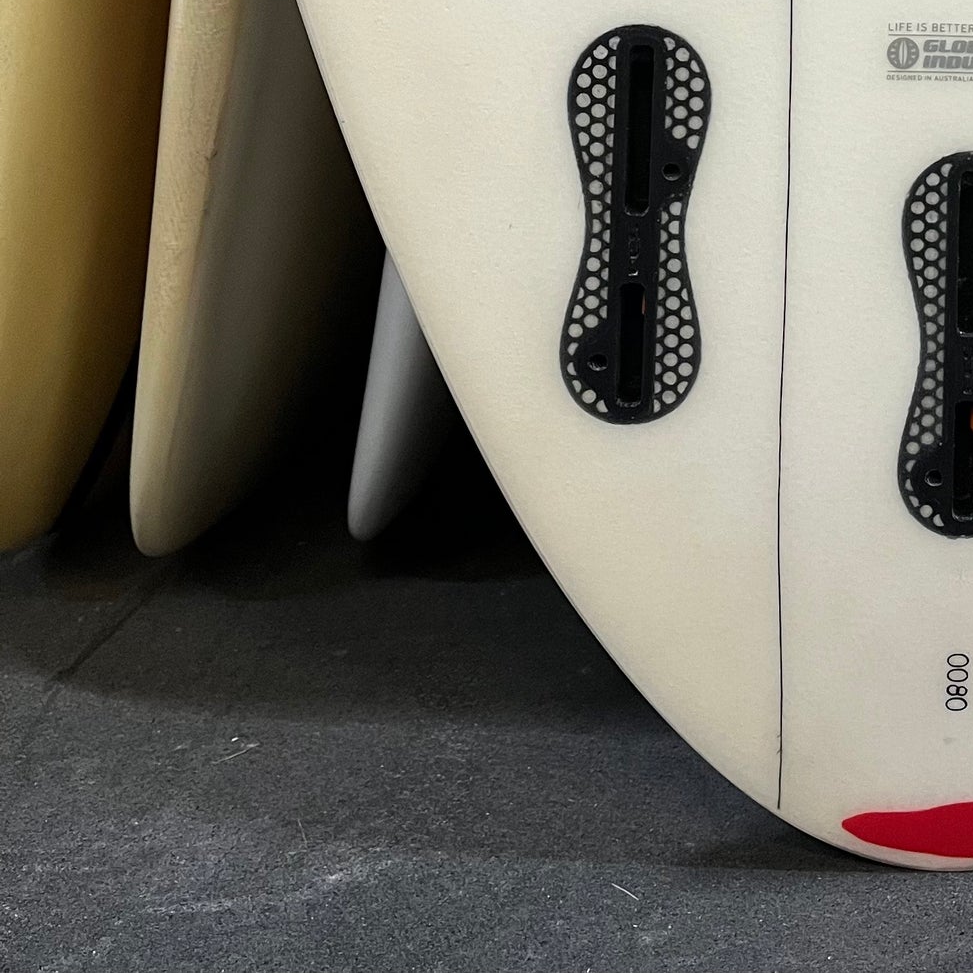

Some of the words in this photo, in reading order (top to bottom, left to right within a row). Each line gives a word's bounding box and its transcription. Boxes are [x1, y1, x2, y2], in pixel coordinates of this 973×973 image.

[887, 22, 913, 32] LIFE
[916, 23, 928, 32] IS
[886, 74, 923, 82] DESIGNED
[933, 75, 973, 83] AUSTRALIA
